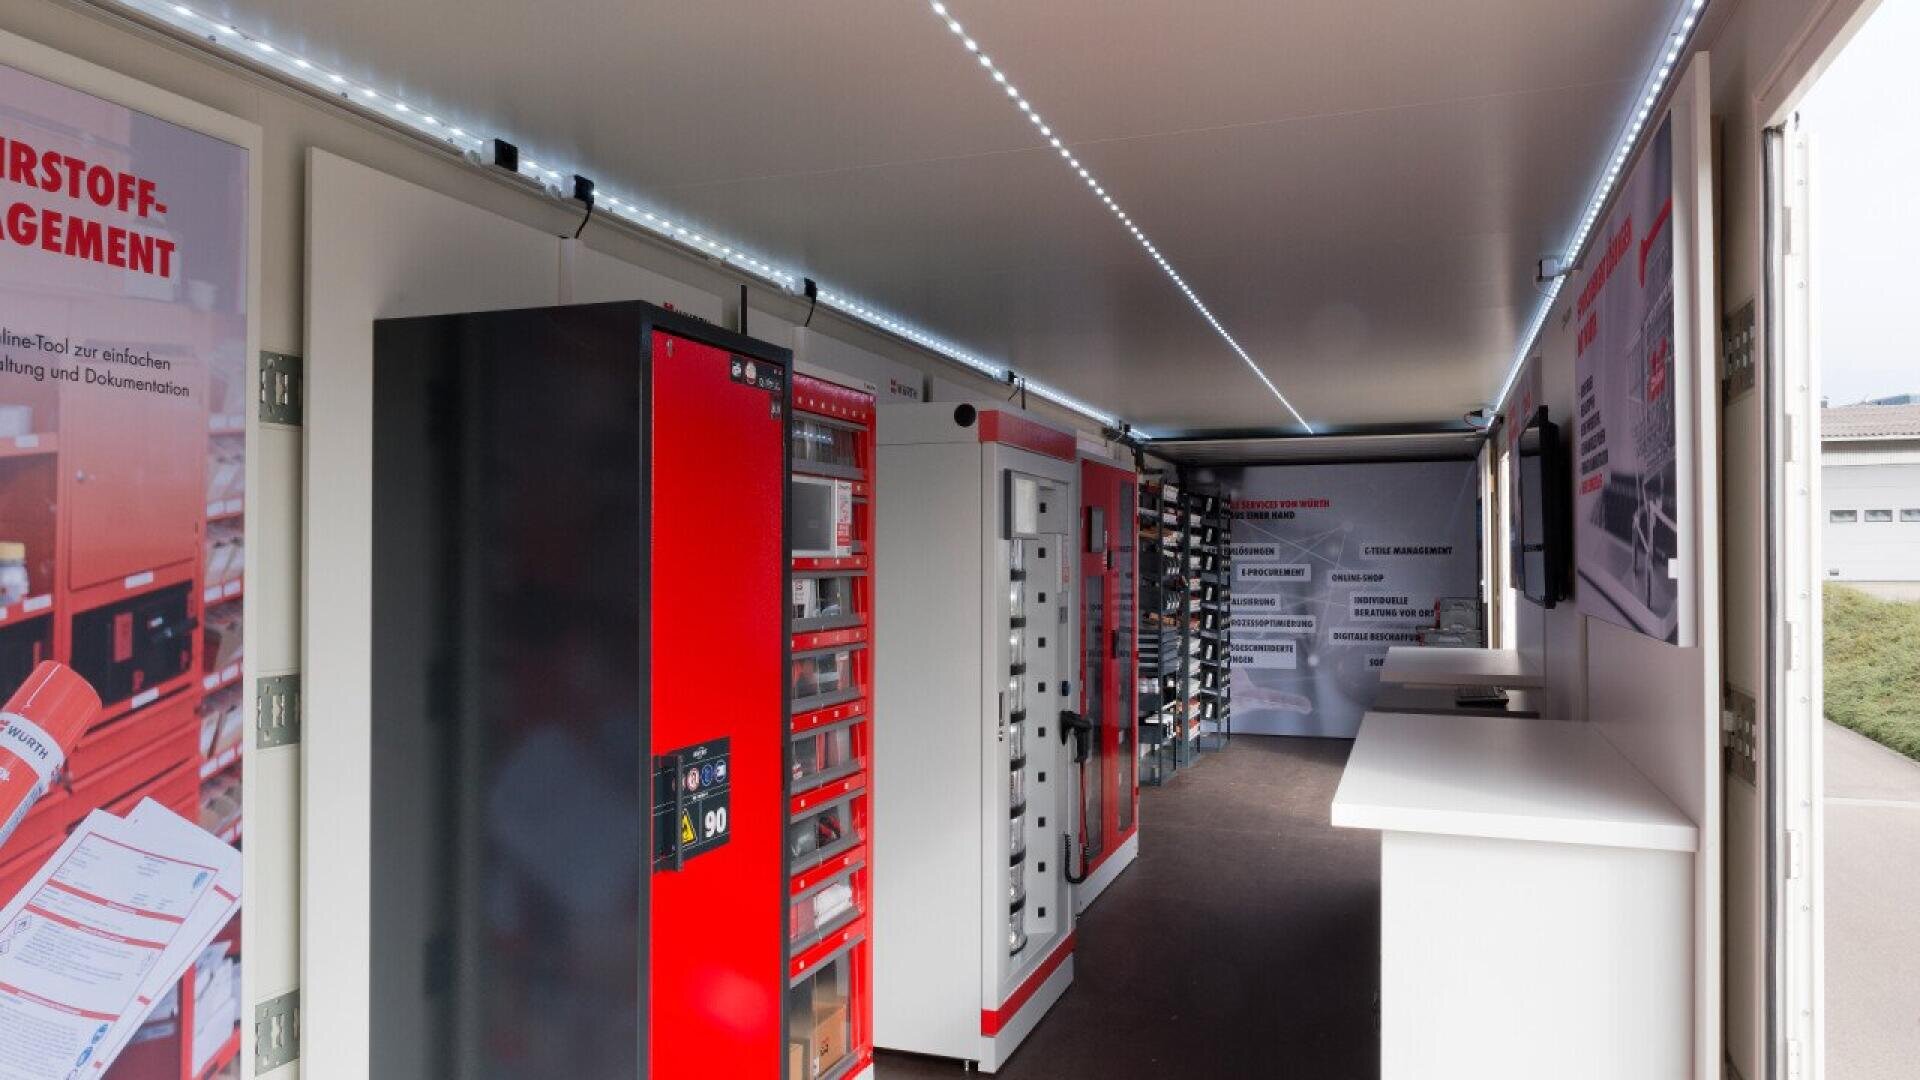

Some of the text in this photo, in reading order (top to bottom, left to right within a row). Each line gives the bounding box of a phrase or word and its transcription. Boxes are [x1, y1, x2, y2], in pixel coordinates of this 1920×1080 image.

[0, 202, 176, 278] GEMENT
[0, 326, 68, 355] line-Tool
[74, 345, 171, 370] zur einfachen
[50, 364, 79, 382] und
[85, 366, 190, 397] Dokumentation
[1247, 511, 1270, 520] EINER
[1271, 511, 1296, 520] HAND
[1364, 546, 1453, 556] C-TEILE MANAGEMENT
[1241, 568, 1305, 577] E-PROCUREMENT
[1331, 573, 1384, 583] ONLINE-SHOP
[1353, 596, 1408, 606] INDIVIDUELLE
[1354, 608, 1397, 618] BERATUNG
[1399, 608, 1417, 618] VOR
[1333, 632, 1368, 642] DIGITALE
[704, 806, 727, 838] 90
